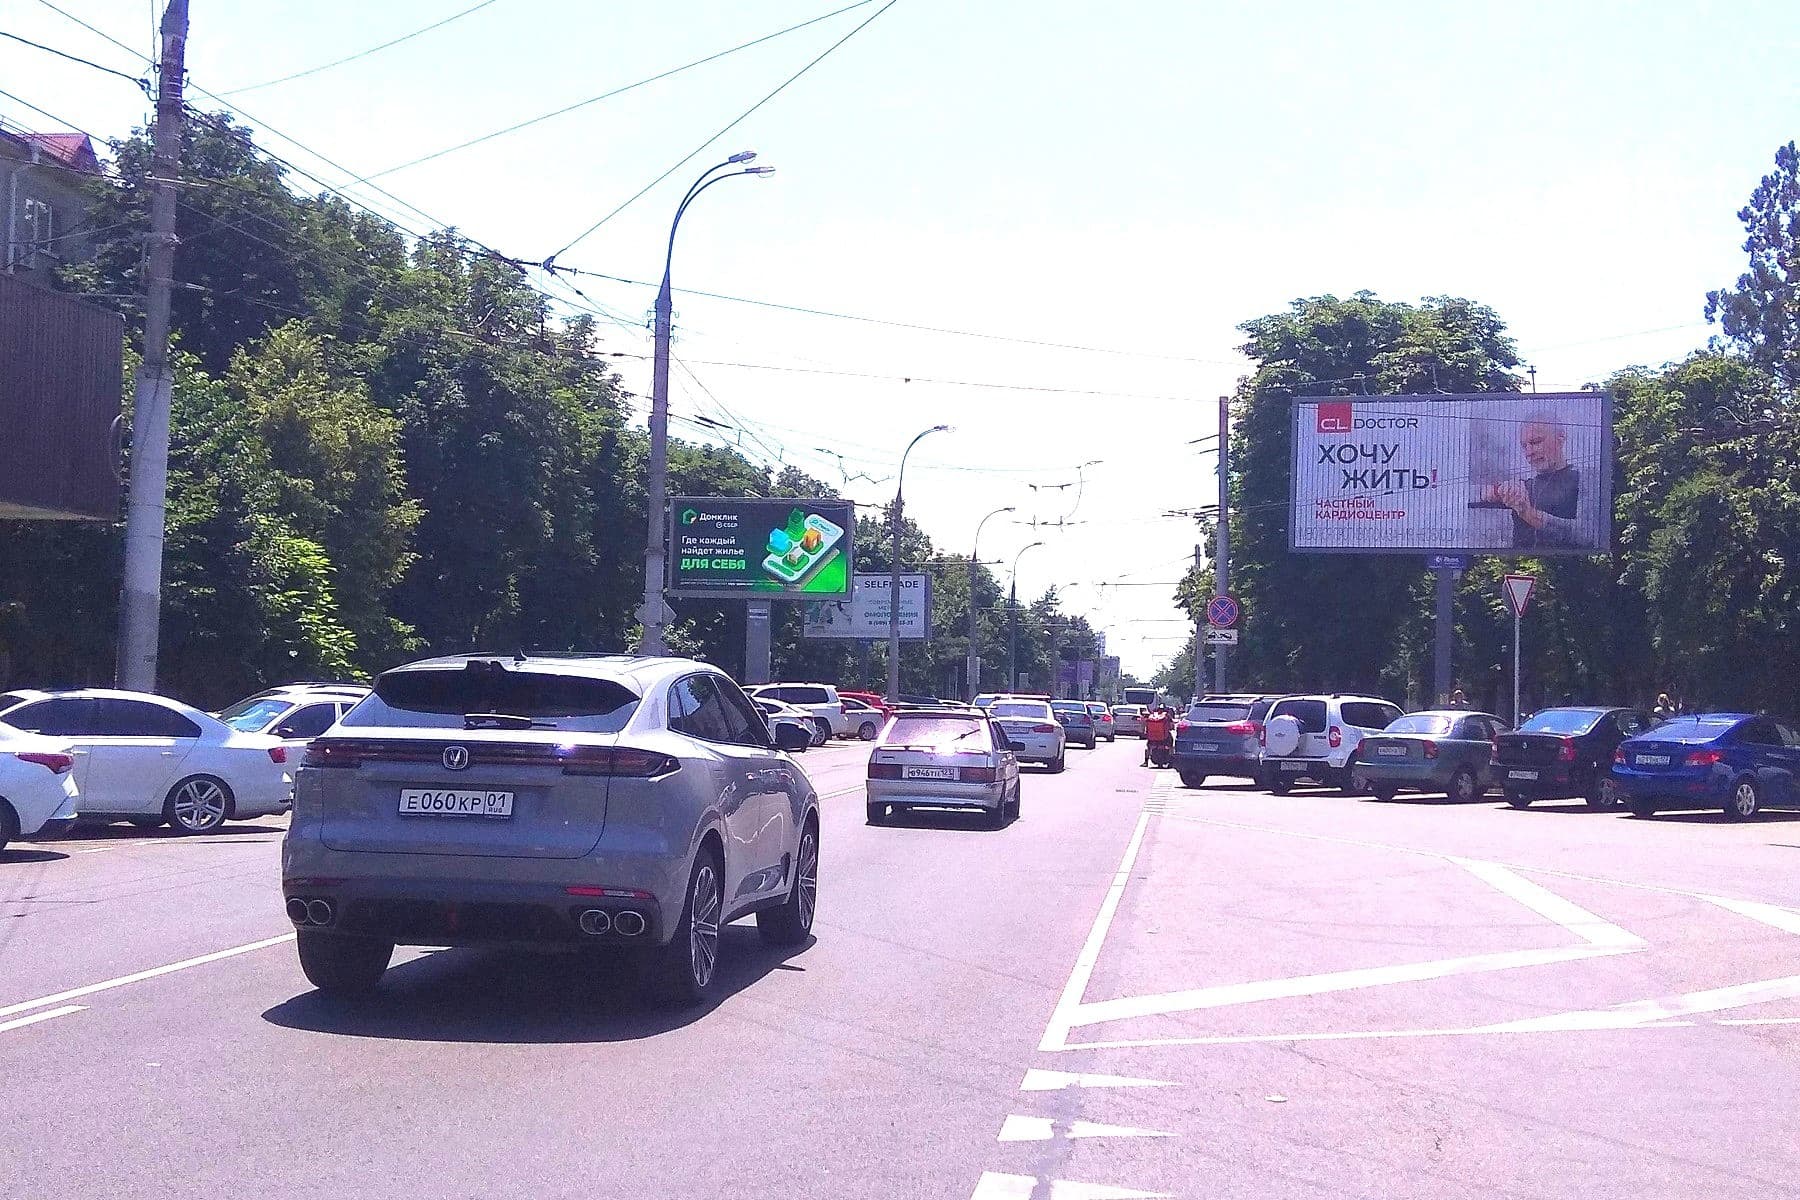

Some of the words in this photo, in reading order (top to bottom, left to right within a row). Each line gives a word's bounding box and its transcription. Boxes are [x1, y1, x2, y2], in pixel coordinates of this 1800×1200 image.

[1320, 418, 1348, 430] CL
[1353, 418, 1418, 429] DOCTOR
[1318, 444, 1399, 464] ХОЧУ
[1341, 469, 1437, 489] ЖИТЬ!
[1315, 499, 1375, 509] ЧАСТНЫЙ
[699, 513, 738, 521] Домклик
[1315, 511, 1406, 521] КАРДИОЦЕНТР
[681, 535, 697, 545] Где
[699, 536, 736, 545] каждый
[681, 546, 713, 556] найдет
[715, 548, 744, 556] жилье
[681, 559, 709, 570] ДЛЯ
[712, 559, 746, 570] СЕБЯ
